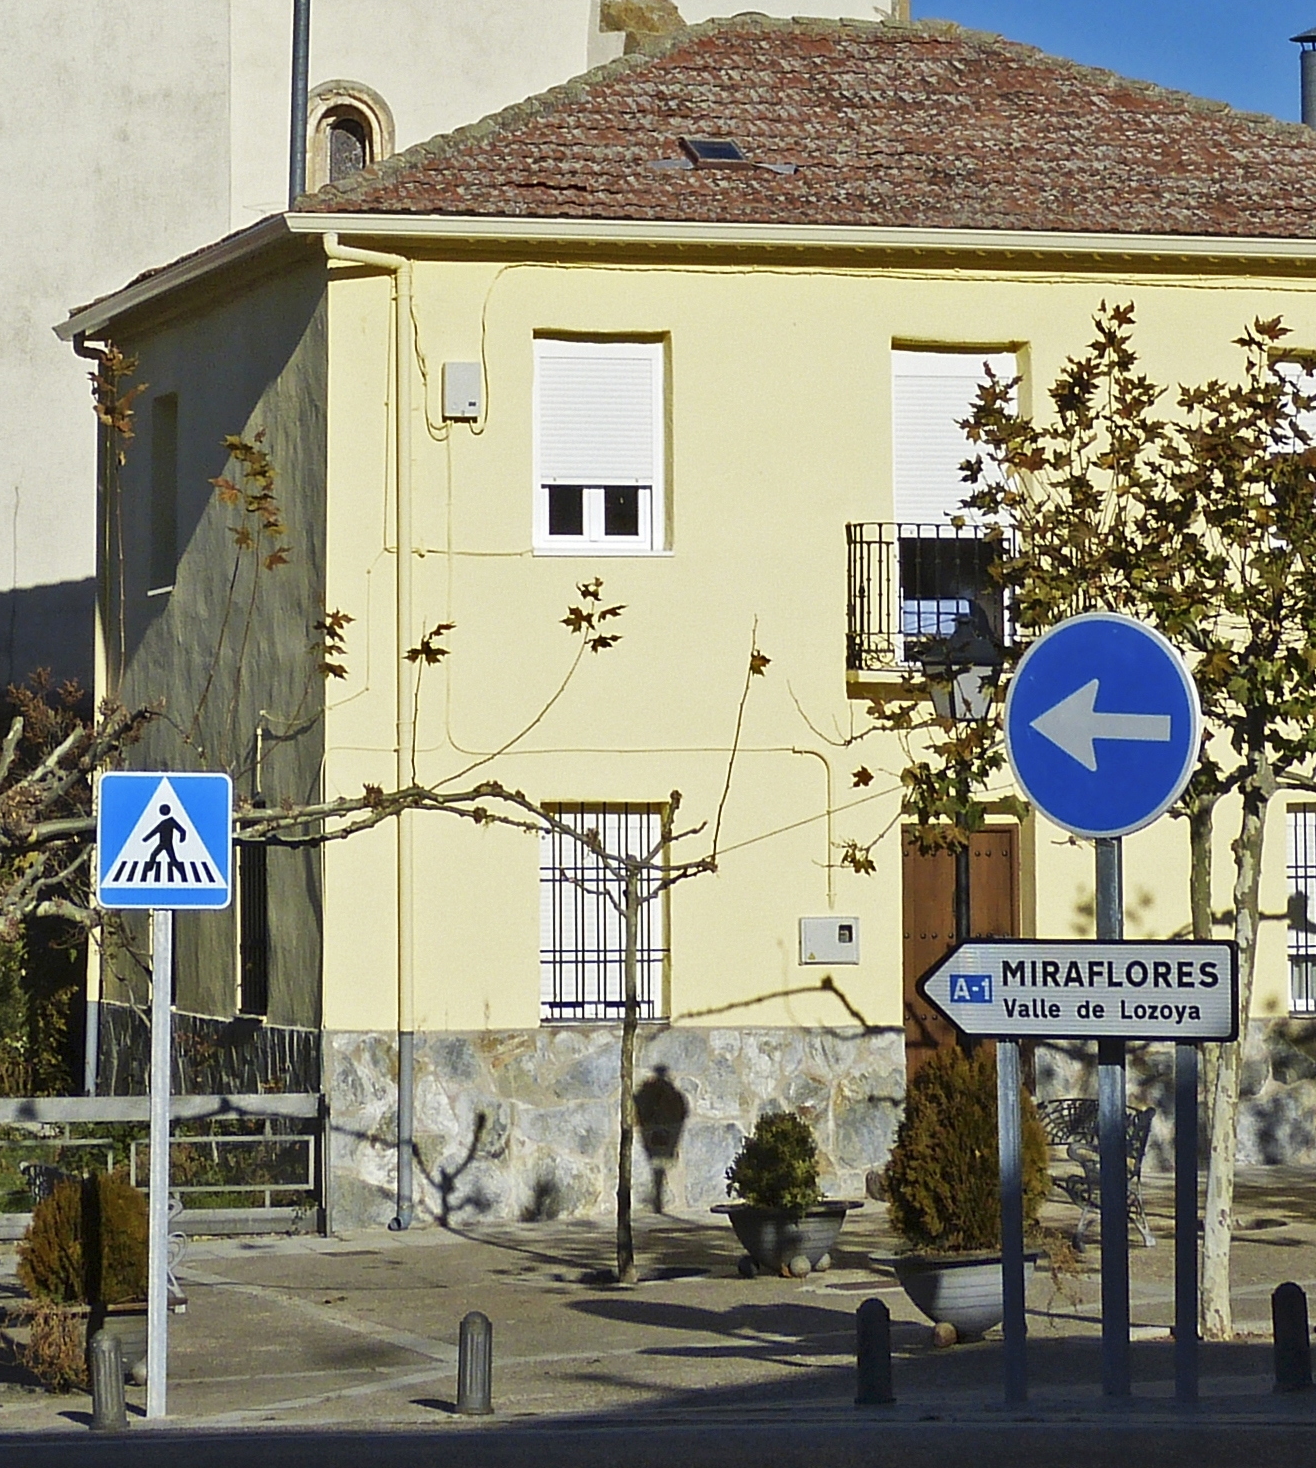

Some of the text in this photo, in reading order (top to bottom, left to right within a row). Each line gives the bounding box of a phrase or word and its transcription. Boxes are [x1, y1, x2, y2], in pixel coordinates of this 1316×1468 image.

[1001, 960, 1220, 989] MIRAFLORES
[953, 977, 991, 1001] A-1
[1003, 998, 1201, 1025] Valle de Lozoya
